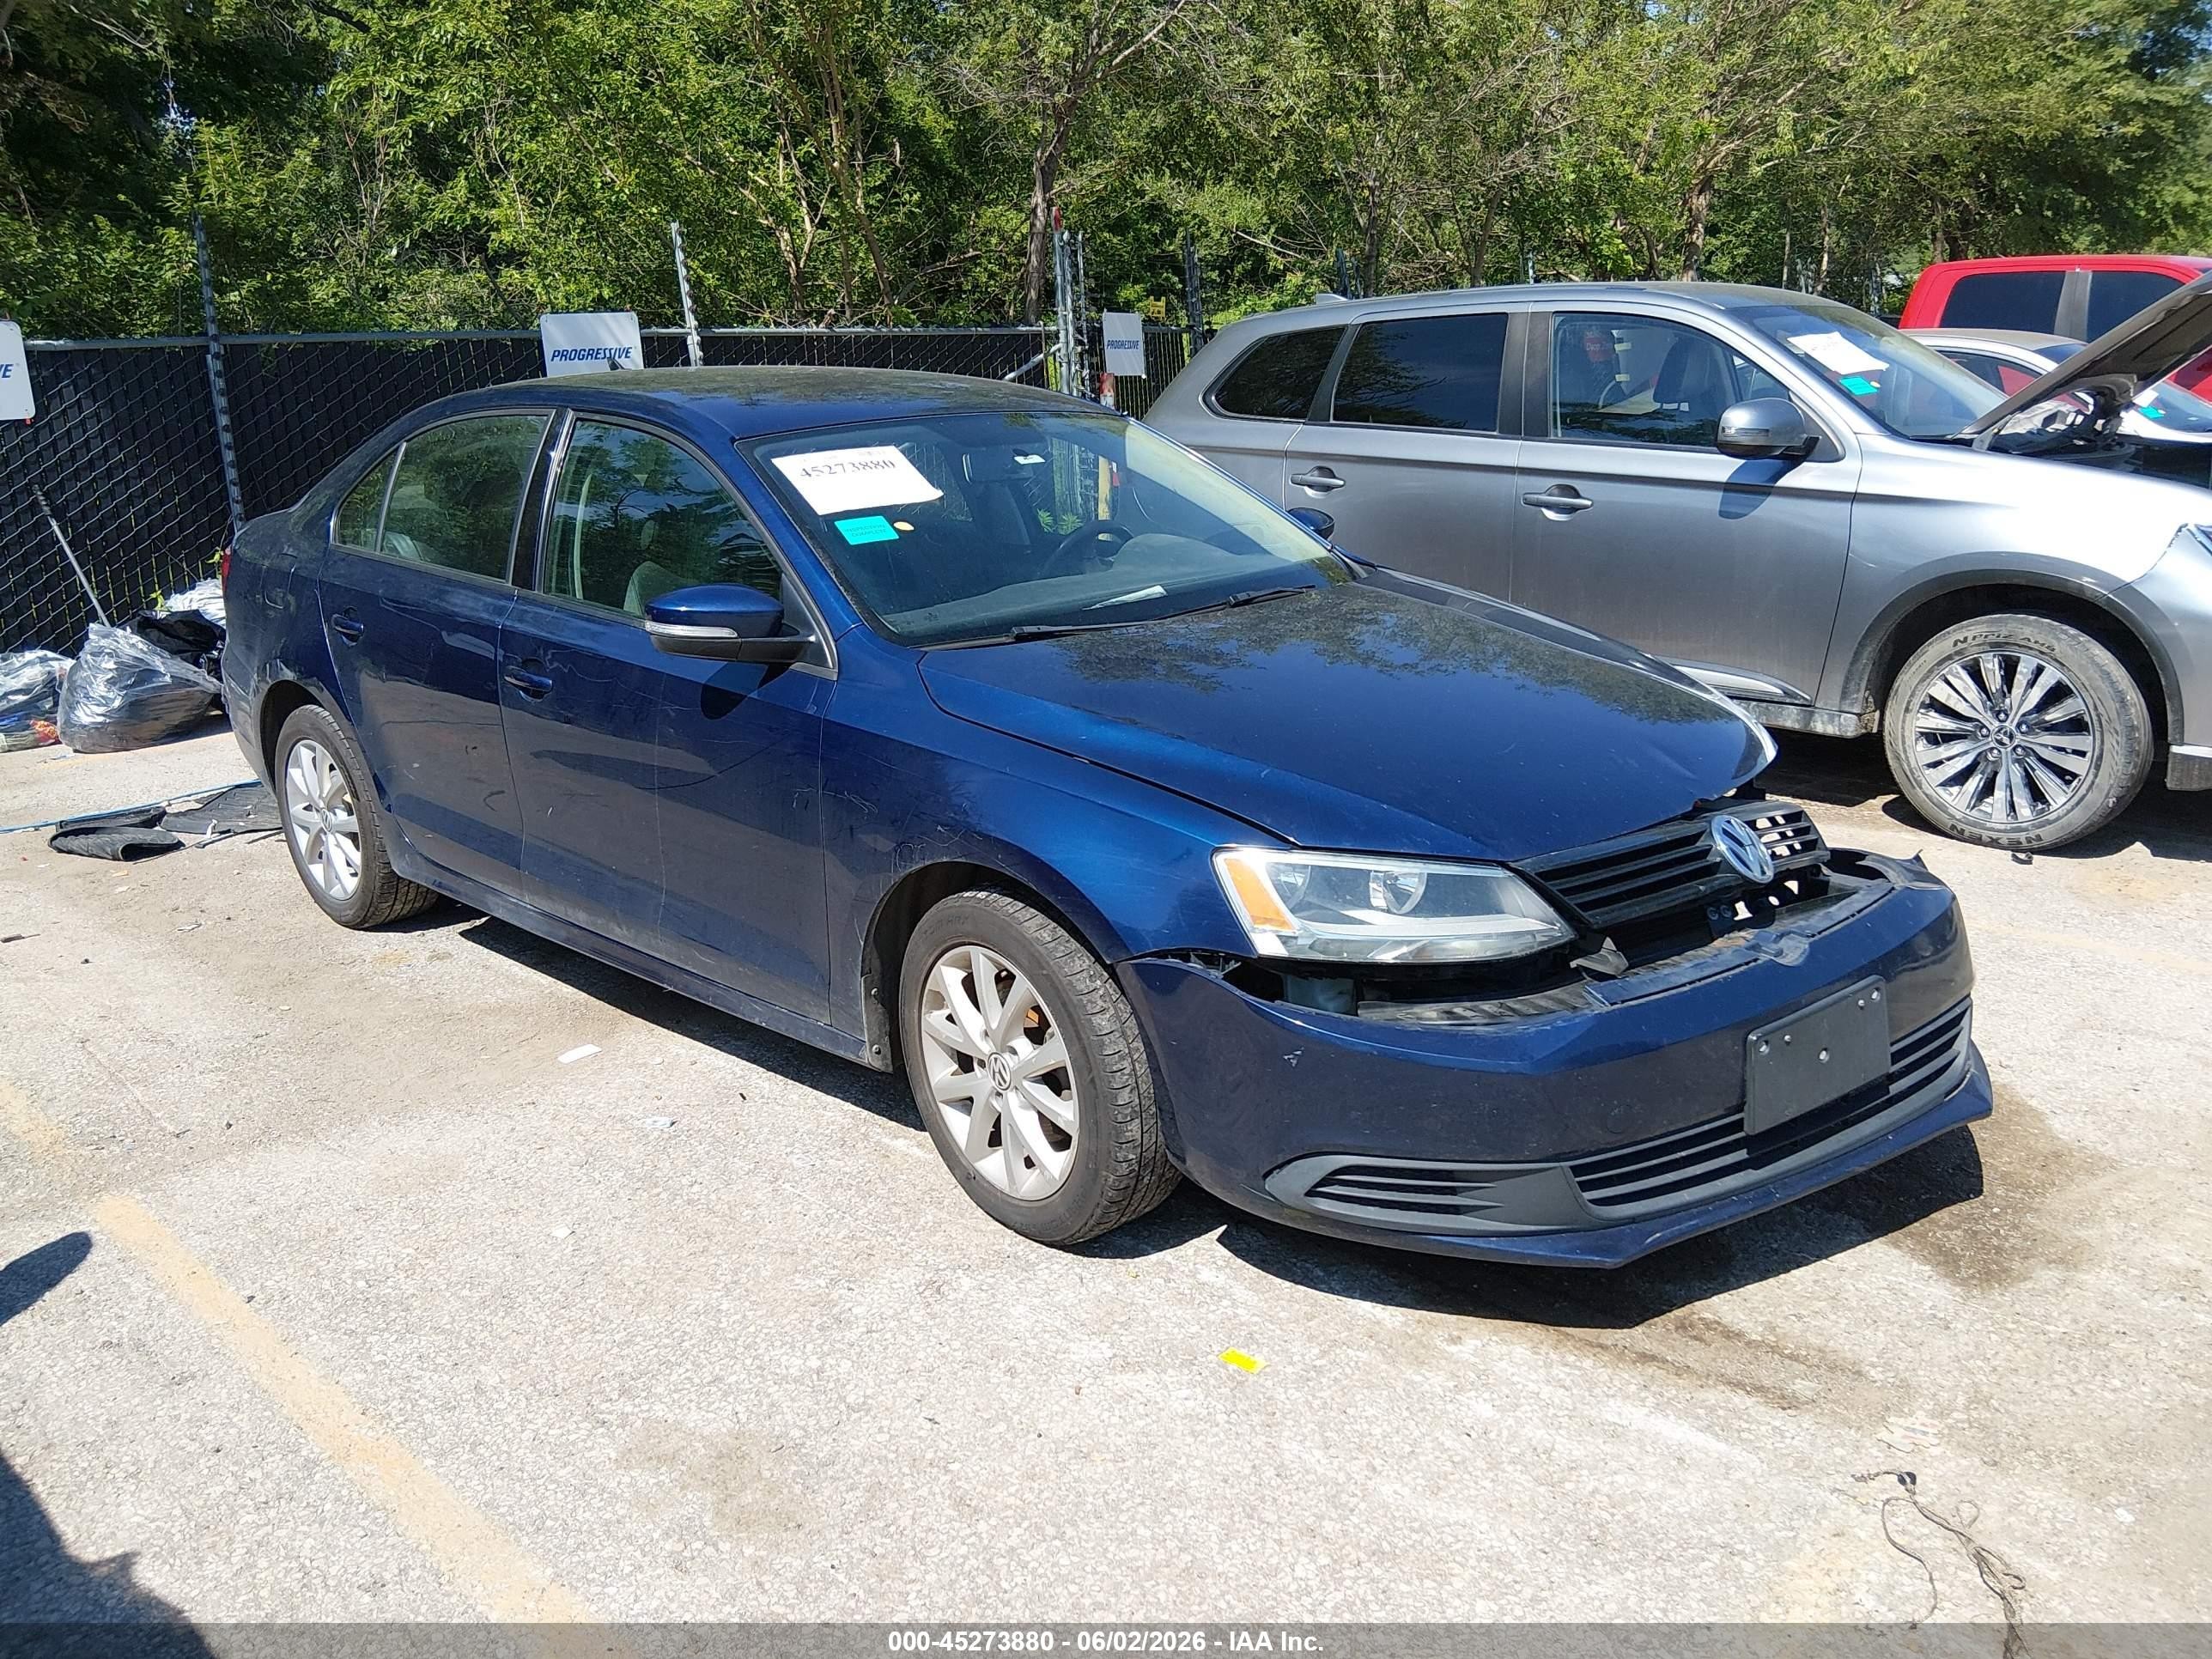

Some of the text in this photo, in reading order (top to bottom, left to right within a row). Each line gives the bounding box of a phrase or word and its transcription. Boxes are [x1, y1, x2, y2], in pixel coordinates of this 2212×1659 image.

[1106, 339, 1140, 350] PROGRESSIVE
[550, 347, 633, 362] PROGRESSIVE
[800, 459, 896, 477] 45273880
[1948, 823, 2044, 846] NEXEN
